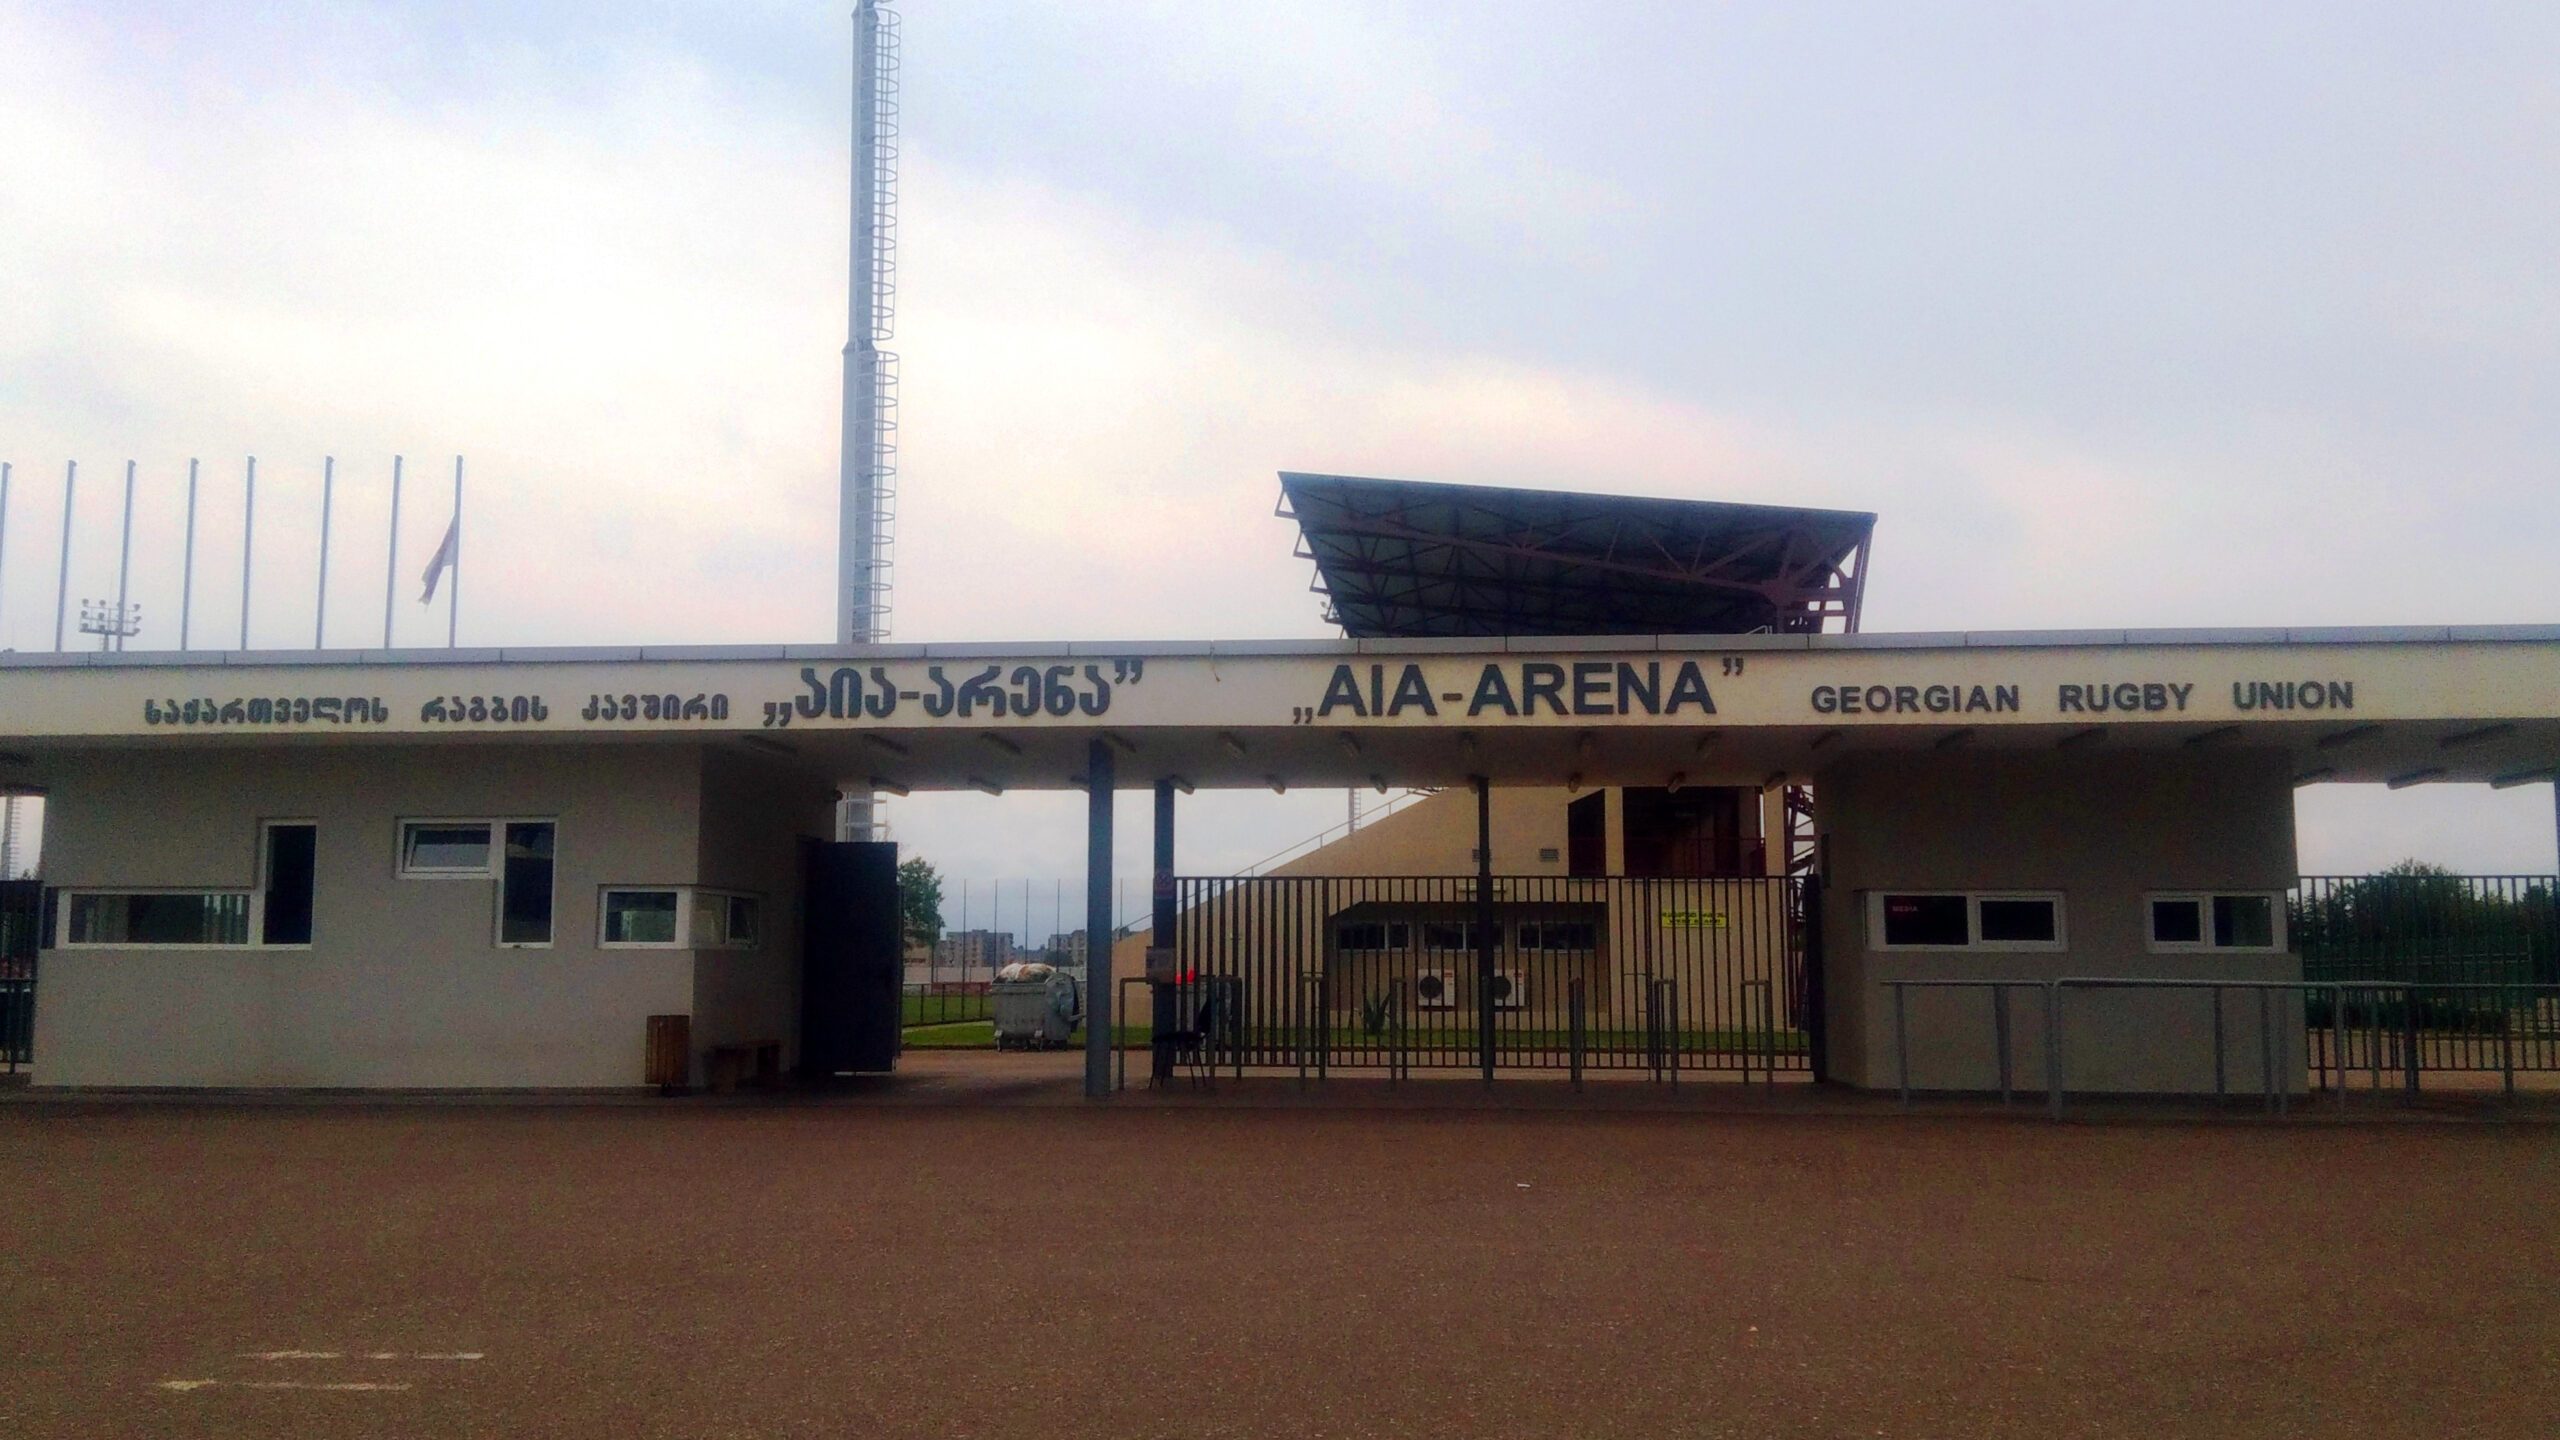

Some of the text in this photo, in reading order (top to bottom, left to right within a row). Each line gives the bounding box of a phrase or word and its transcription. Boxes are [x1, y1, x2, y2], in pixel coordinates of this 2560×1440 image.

[144, 693, 729, 725] საქართველოს რაგბის კავშირი
[1810, 680, 2354, 714] GEORGIAN RUGBY UNION
